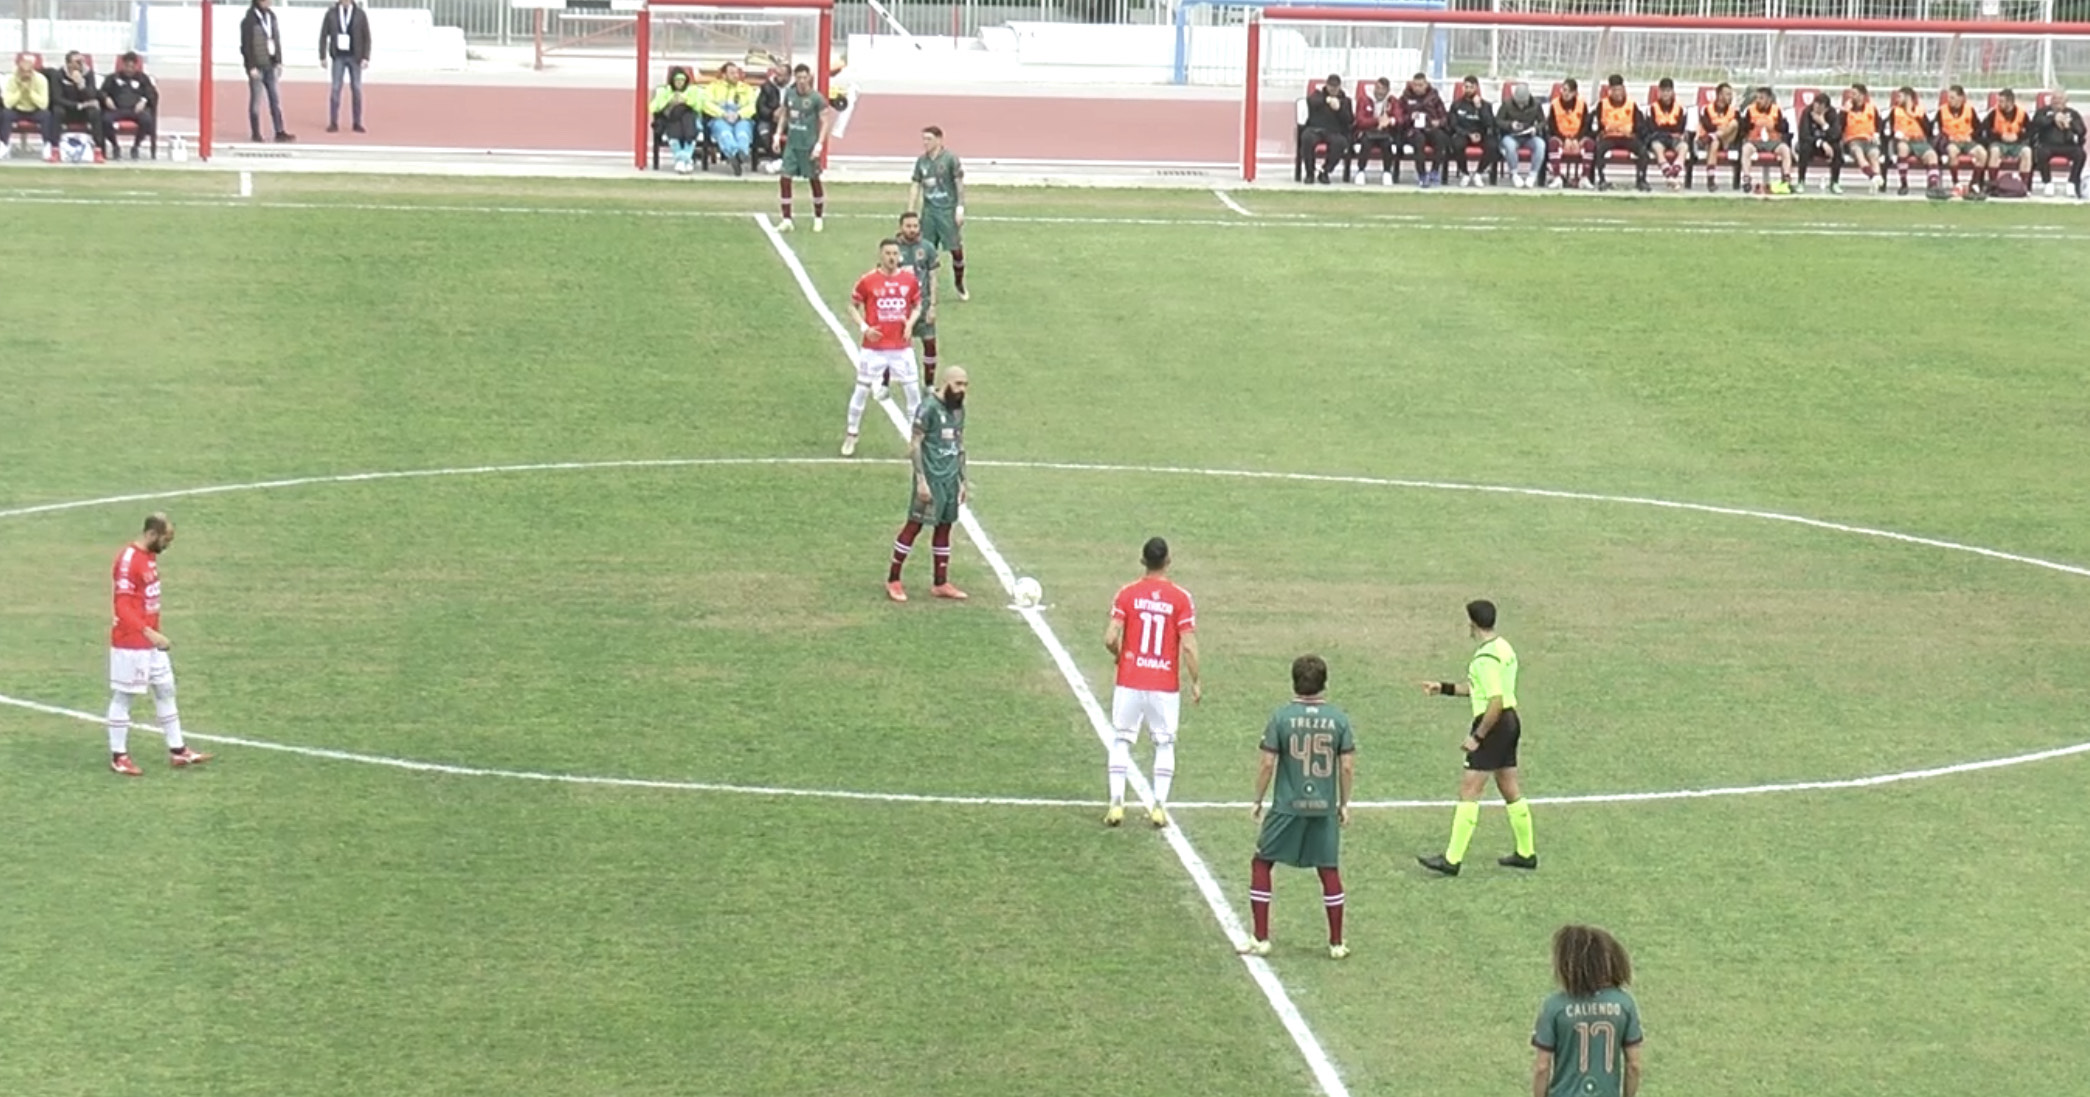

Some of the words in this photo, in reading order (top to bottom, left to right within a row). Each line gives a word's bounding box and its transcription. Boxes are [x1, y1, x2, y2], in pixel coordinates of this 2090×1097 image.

[1140, 612, 1165, 656] 11
[1290, 717, 1336, 729] TREZZA
[1290, 733, 1333, 777] 45
[1566, 1003, 1620, 1017] CALIENDO
[1575, 1021, 1614, 1073] 17
